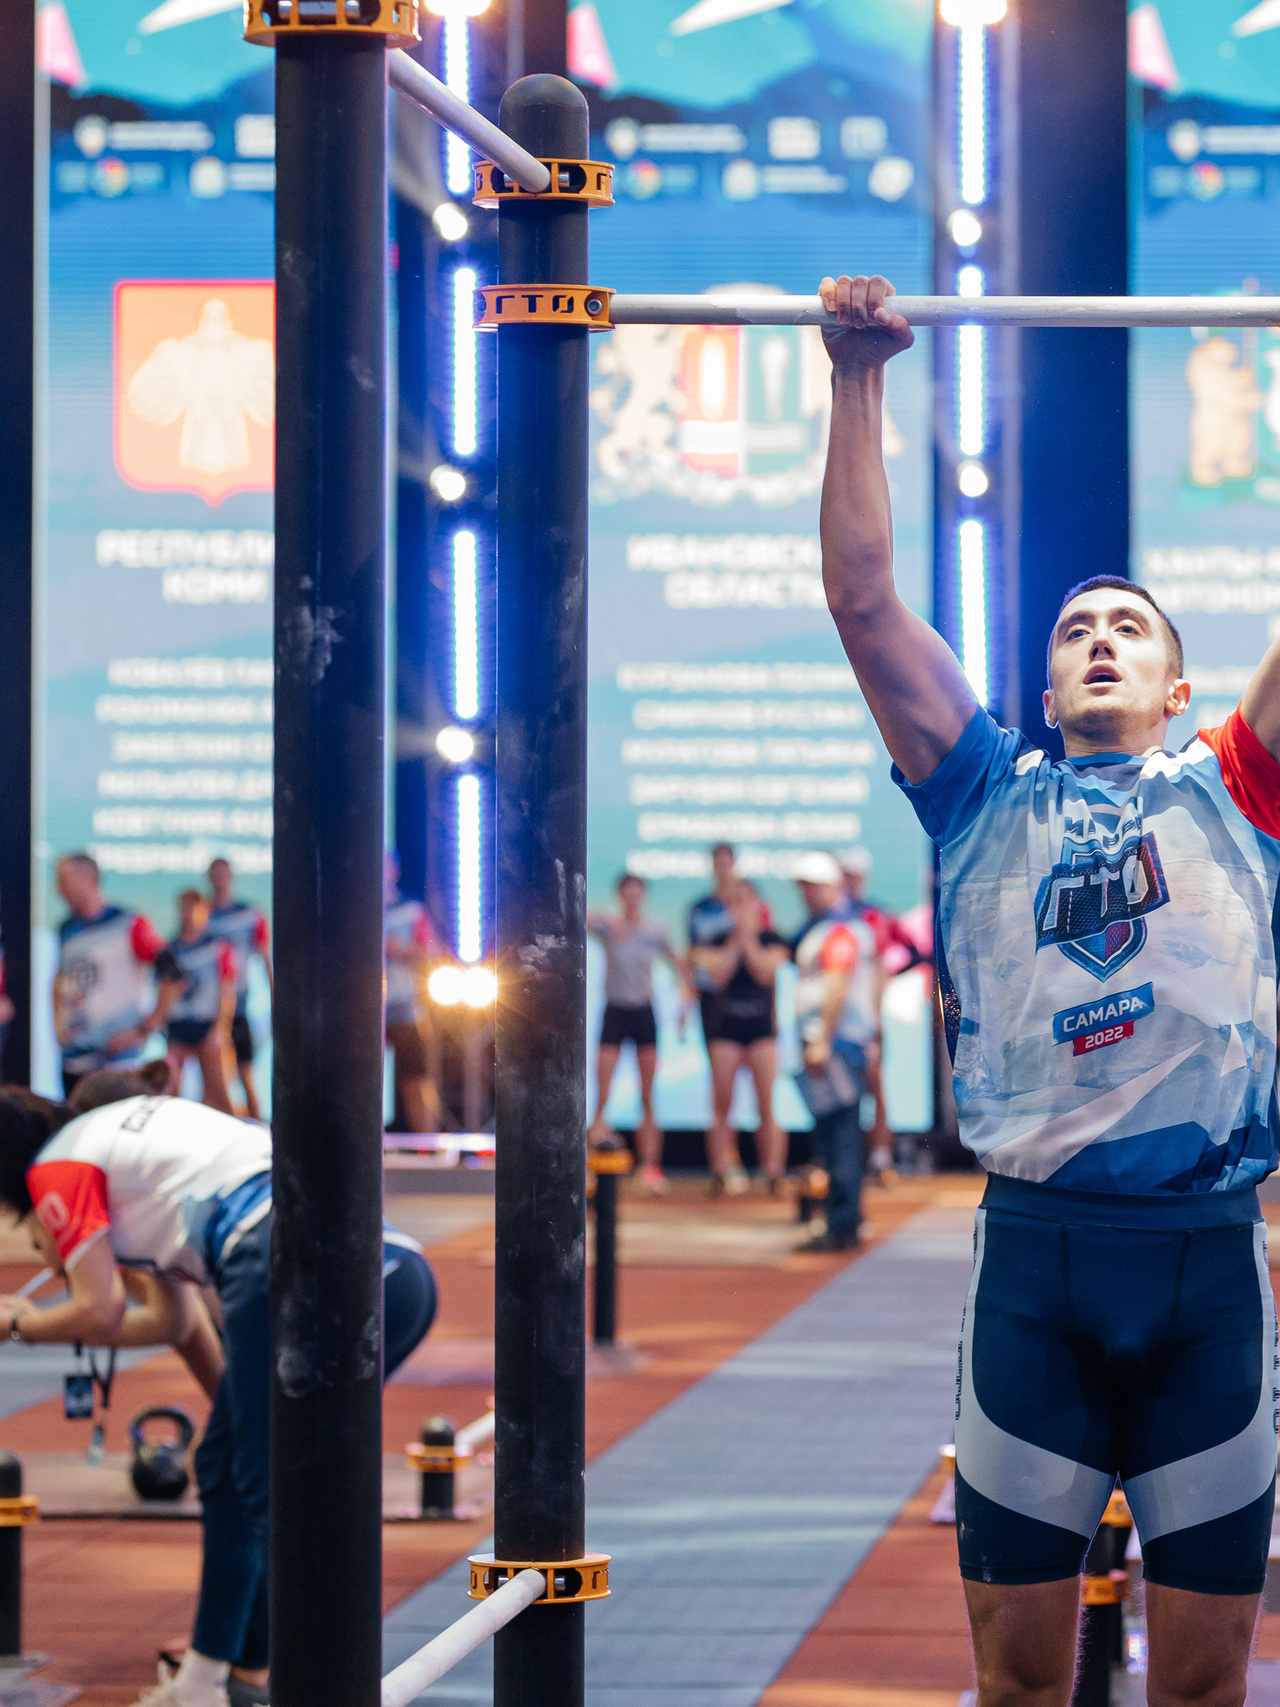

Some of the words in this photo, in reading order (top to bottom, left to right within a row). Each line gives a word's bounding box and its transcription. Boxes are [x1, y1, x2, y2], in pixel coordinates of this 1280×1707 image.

[496, 294, 575, 315] ГТО
[1063, 996, 1147, 1033] САМАРА
[1085, 1025, 1124, 1049] 2022
